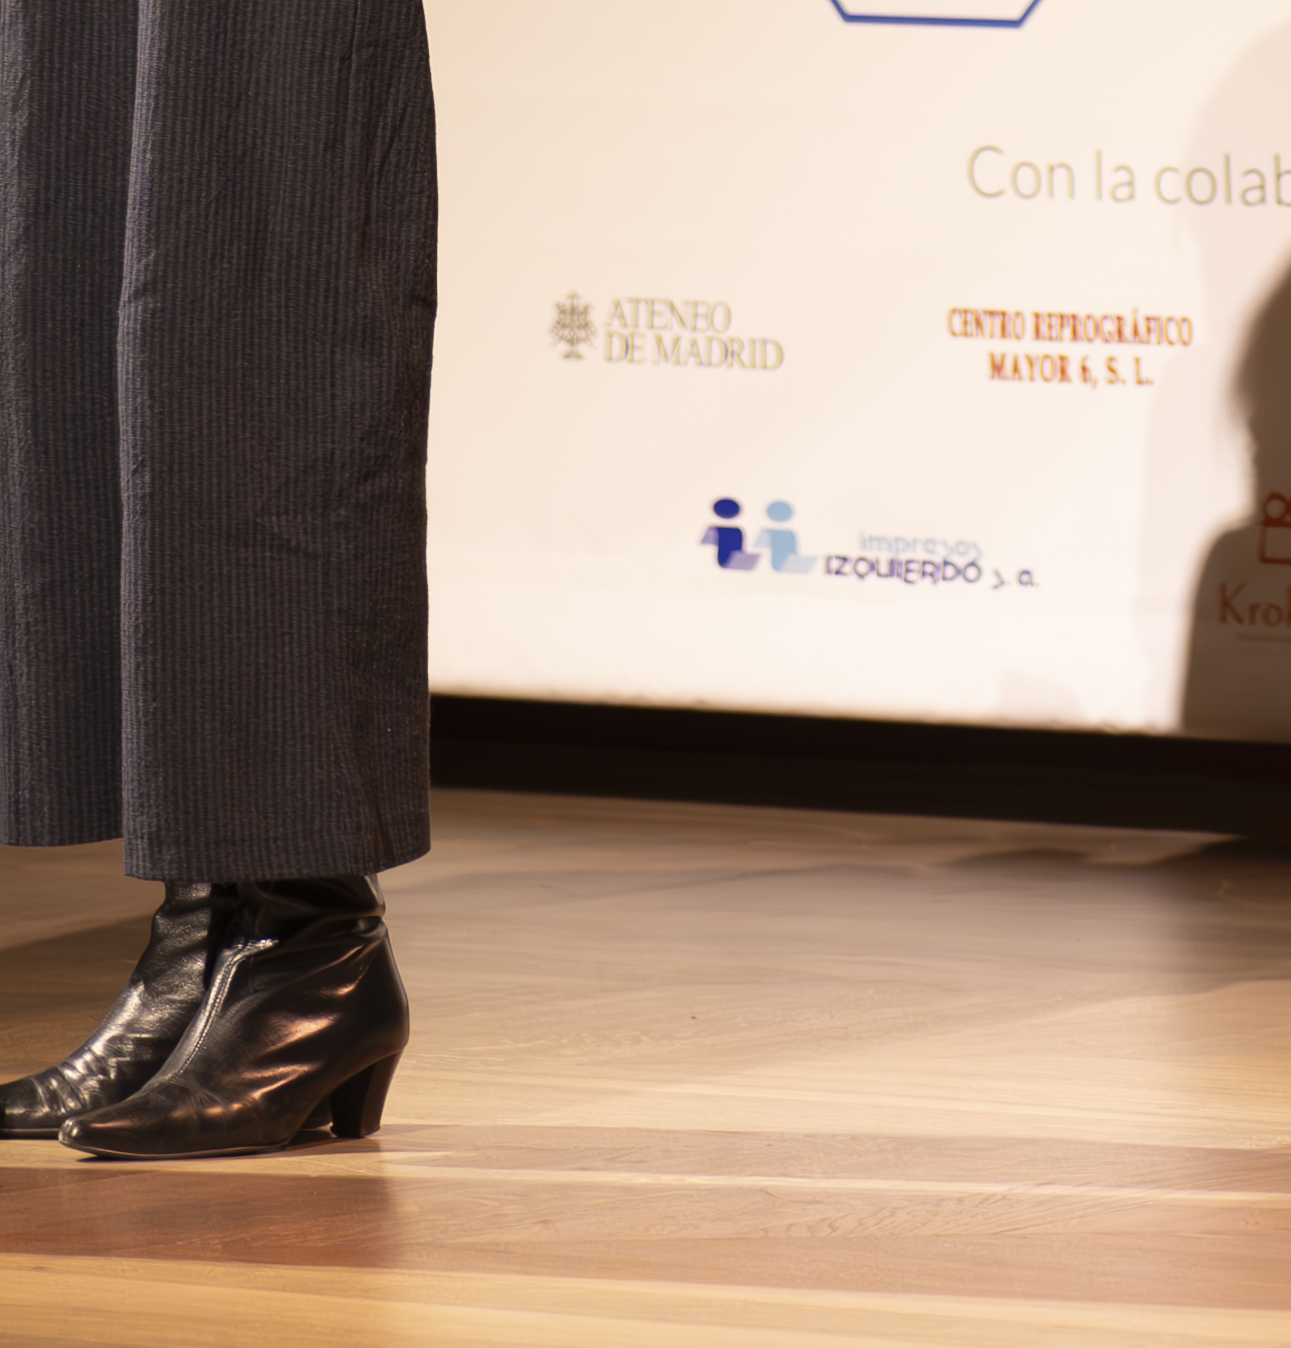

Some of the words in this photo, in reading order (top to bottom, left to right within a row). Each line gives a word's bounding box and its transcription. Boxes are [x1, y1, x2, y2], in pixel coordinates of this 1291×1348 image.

[967, 146, 1075, 201] Con
[1095, 149, 1136, 203] la
[609, 297, 732, 333] ATENEO
[948, 307, 1025, 340] CENTRO
[1032, 308, 1193, 346] REPROGRÁFICO
[604, 333, 645, 365] DE
[652, 336, 784, 370] MADRID
[989, 352, 1071, 383] MAYOR
[1080, 356, 1097, 389] 6,
[1105, 356, 1127, 385] S.
[1135, 357, 1155, 385] L.
[859, 529, 982, 560] impresos
